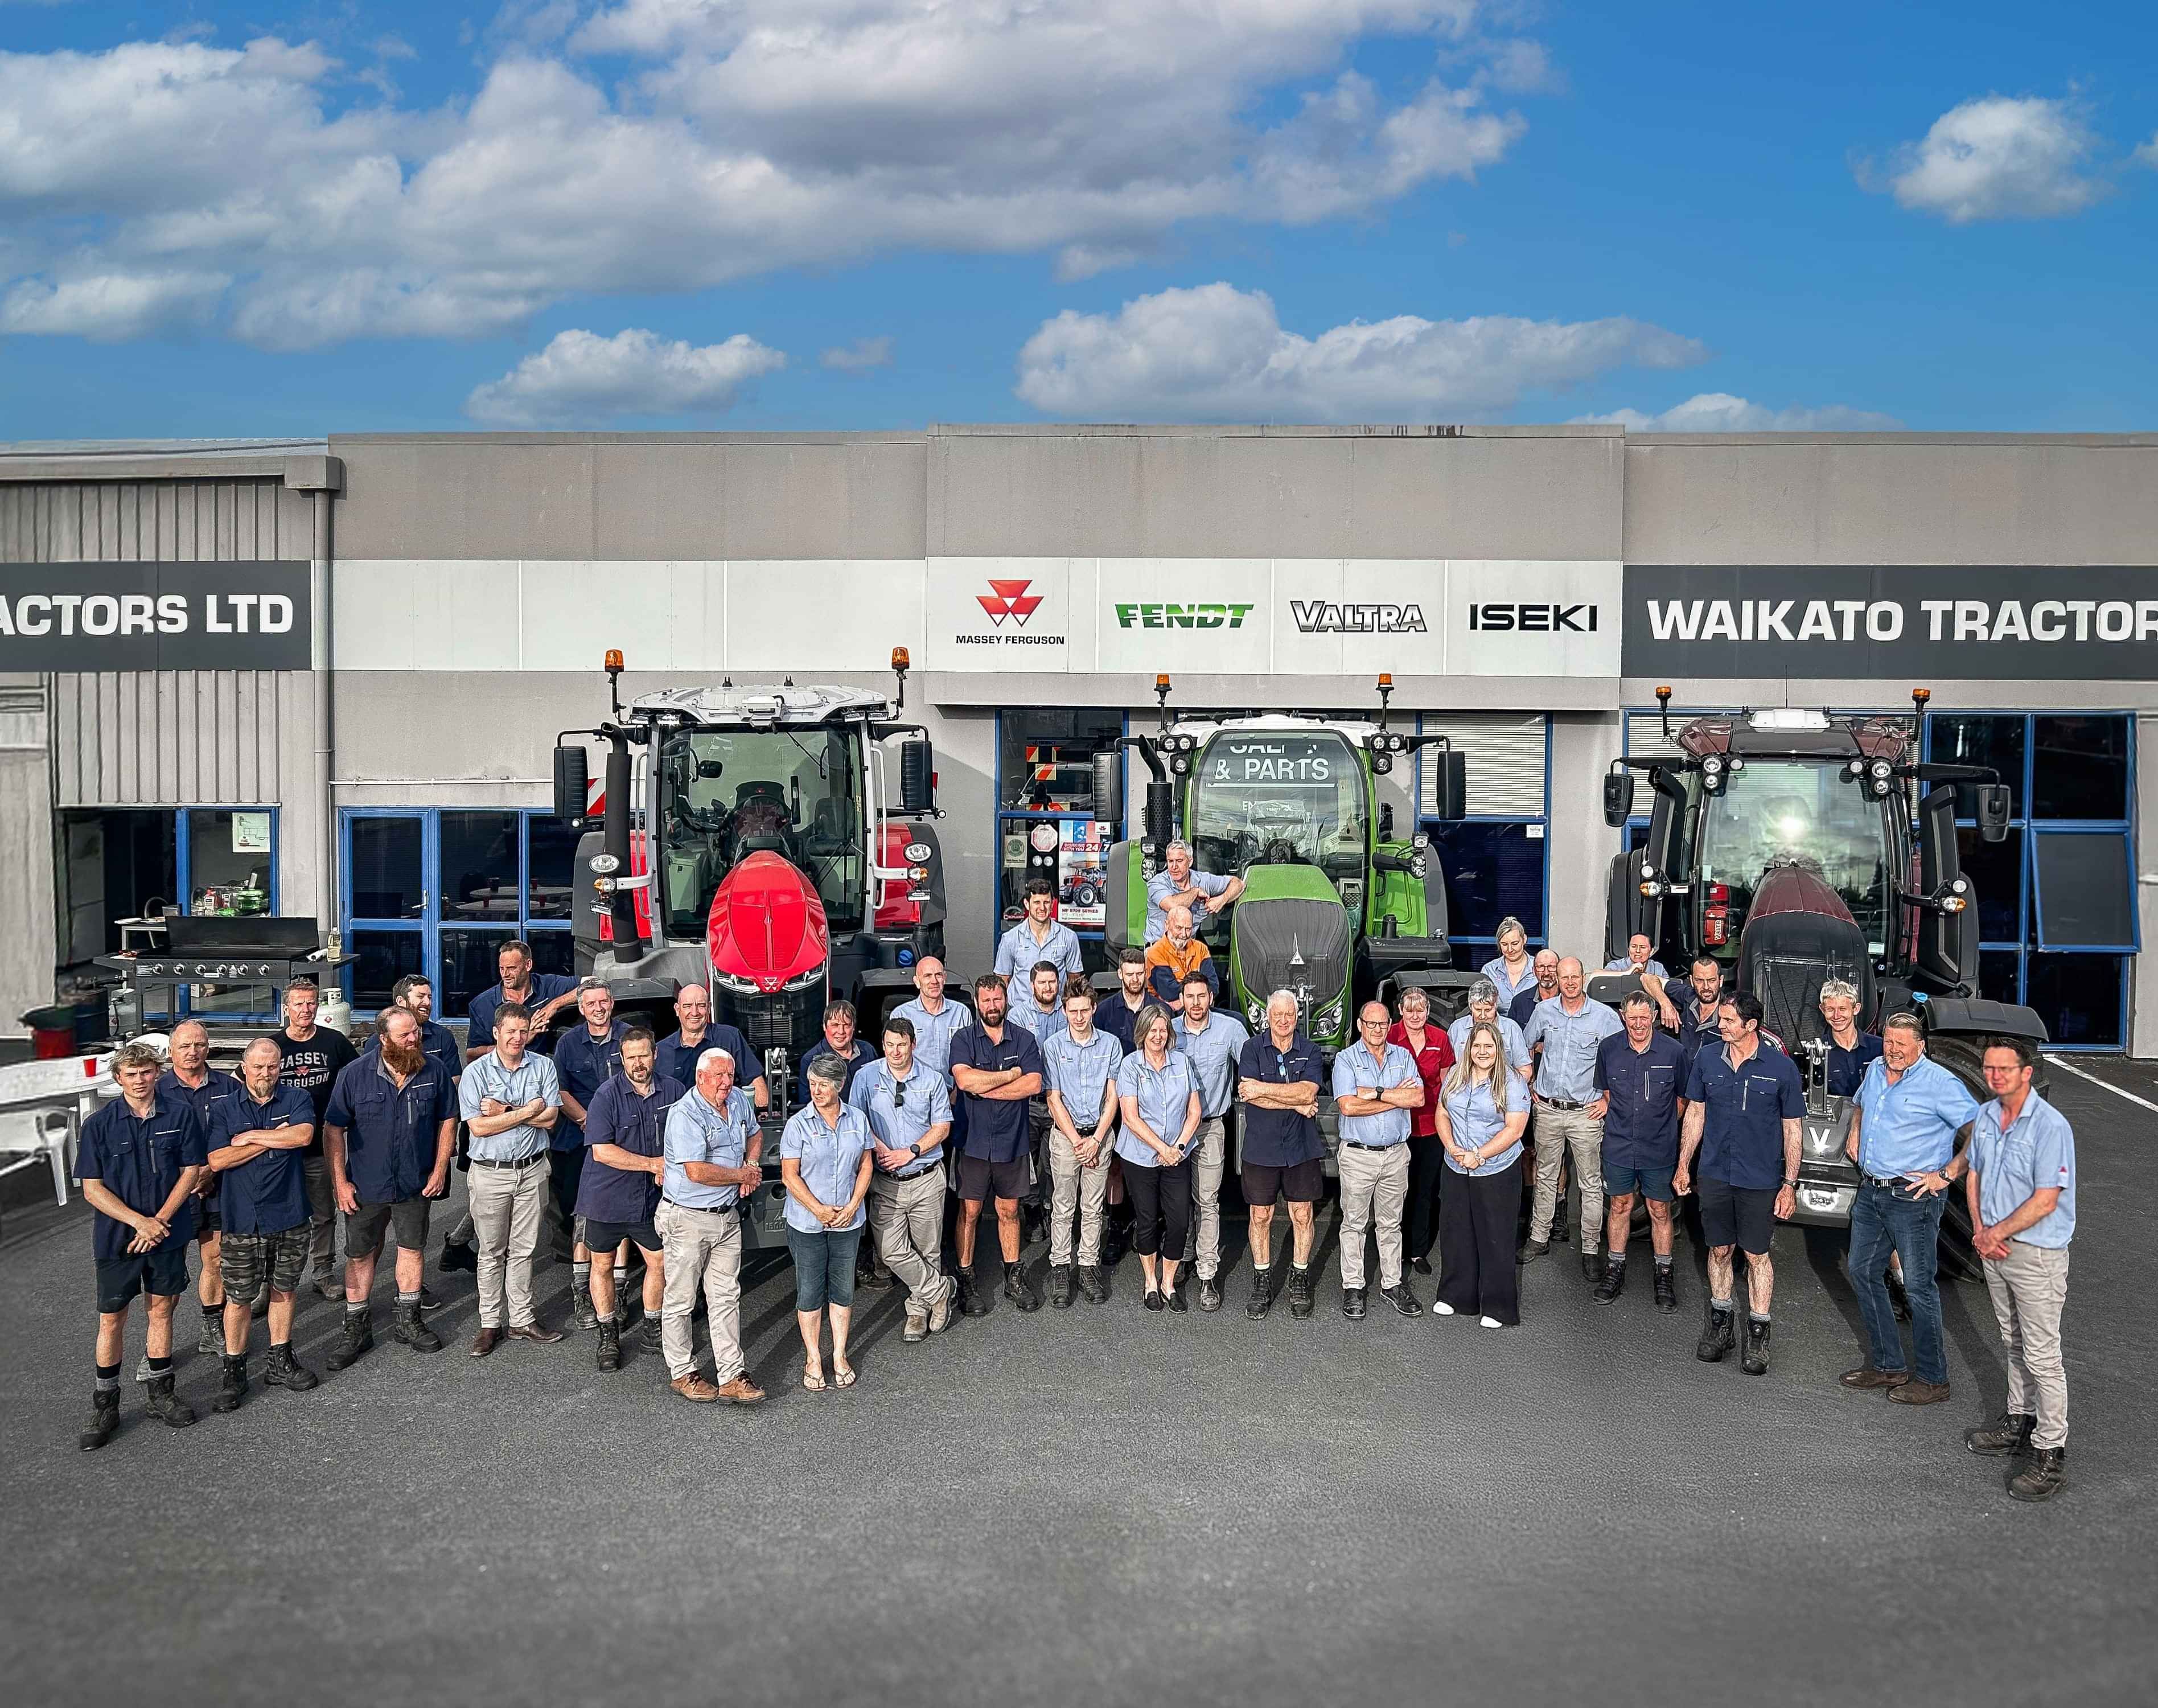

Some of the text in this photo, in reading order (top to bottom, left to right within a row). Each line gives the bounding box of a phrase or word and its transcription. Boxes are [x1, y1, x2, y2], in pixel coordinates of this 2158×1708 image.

[206, 594, 294, 633] LTD
[1115, 604, 1254, 629] FENDT
[1290, 601, 1428, 633] VALTRA
[1470, 603, 1597, 632] ISEKI
[1647, 600, 2158, 642] WAIKATO TRACTOR
[956, 635, 1064, 645] MASSEY FERGUSON
[1215, 758, 1329, 781] & PARTS
[1086, 843, 1099, 852] 24
[280, 1071, 330, 1087] ERGUSON
